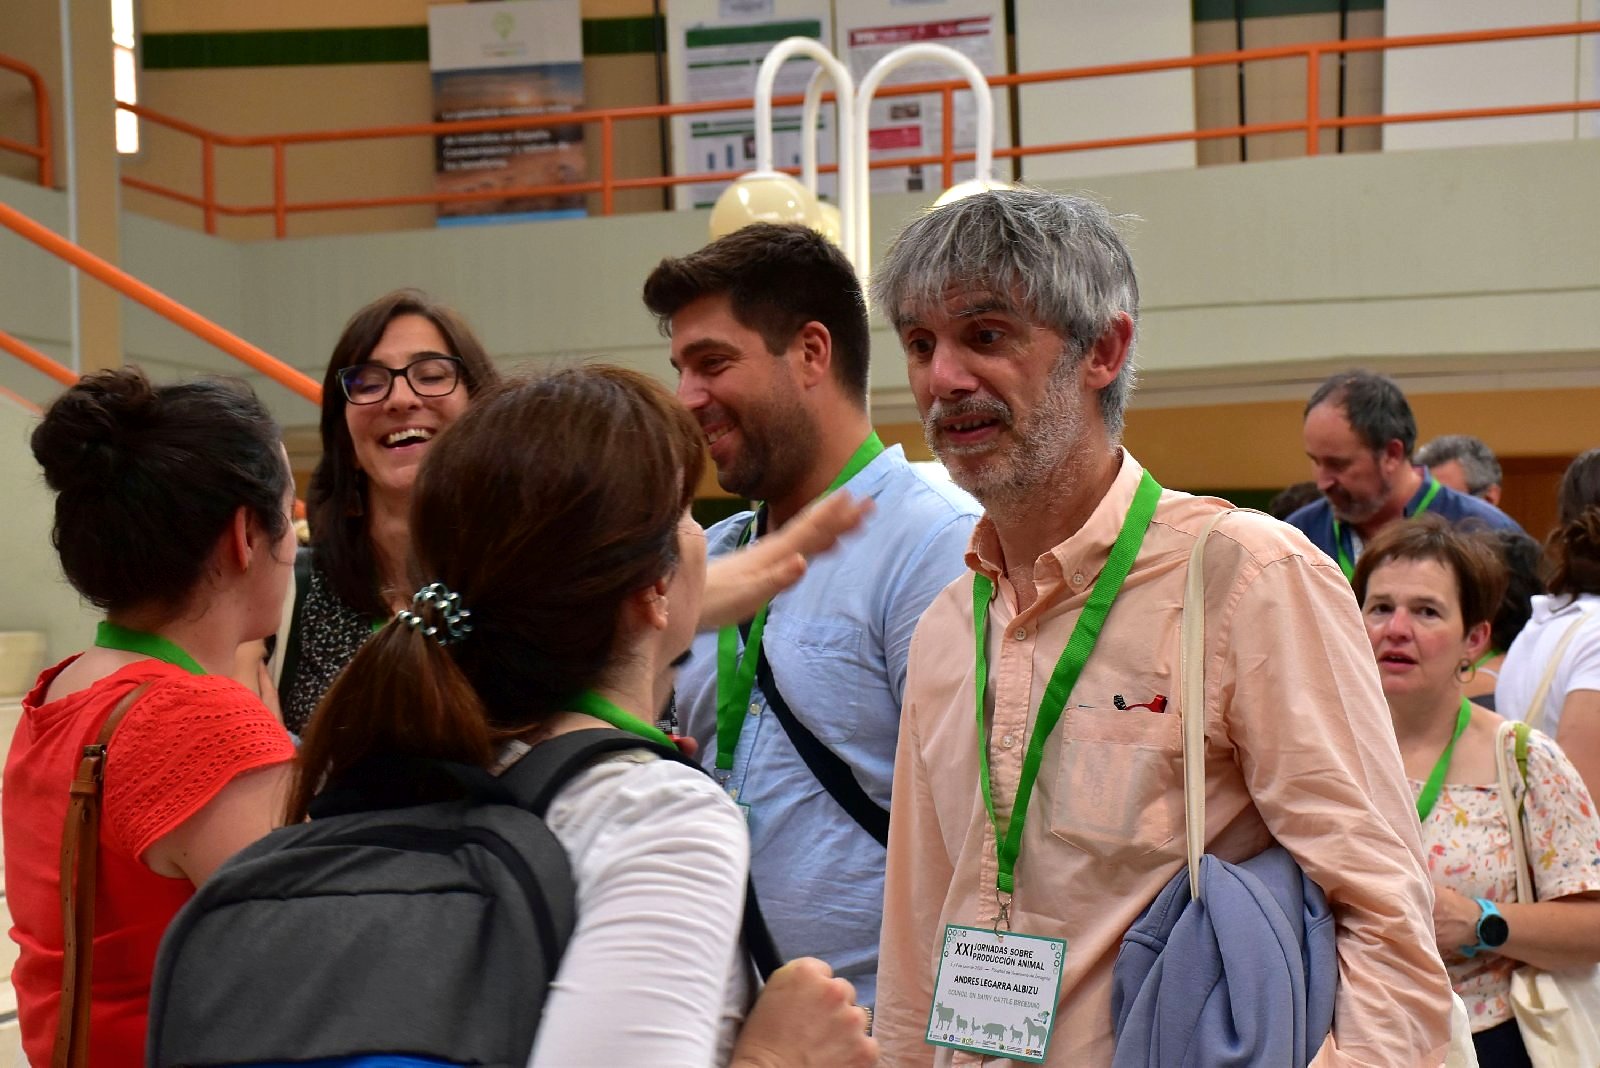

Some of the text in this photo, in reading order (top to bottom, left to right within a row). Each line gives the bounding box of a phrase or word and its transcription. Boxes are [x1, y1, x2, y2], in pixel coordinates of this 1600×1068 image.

[955, 943, 1034, 959] XXI JORNADAS SOBRE
[972, 953, 1045, 971] PRODUCCIÓN ANIMAL
[954, 975, 1039, 995] ANDRES LEGARRA ALBIZU
[993, 996, 1013, 1005] CATTLE
[1013, 999, 1040, 1010] BREEDING
